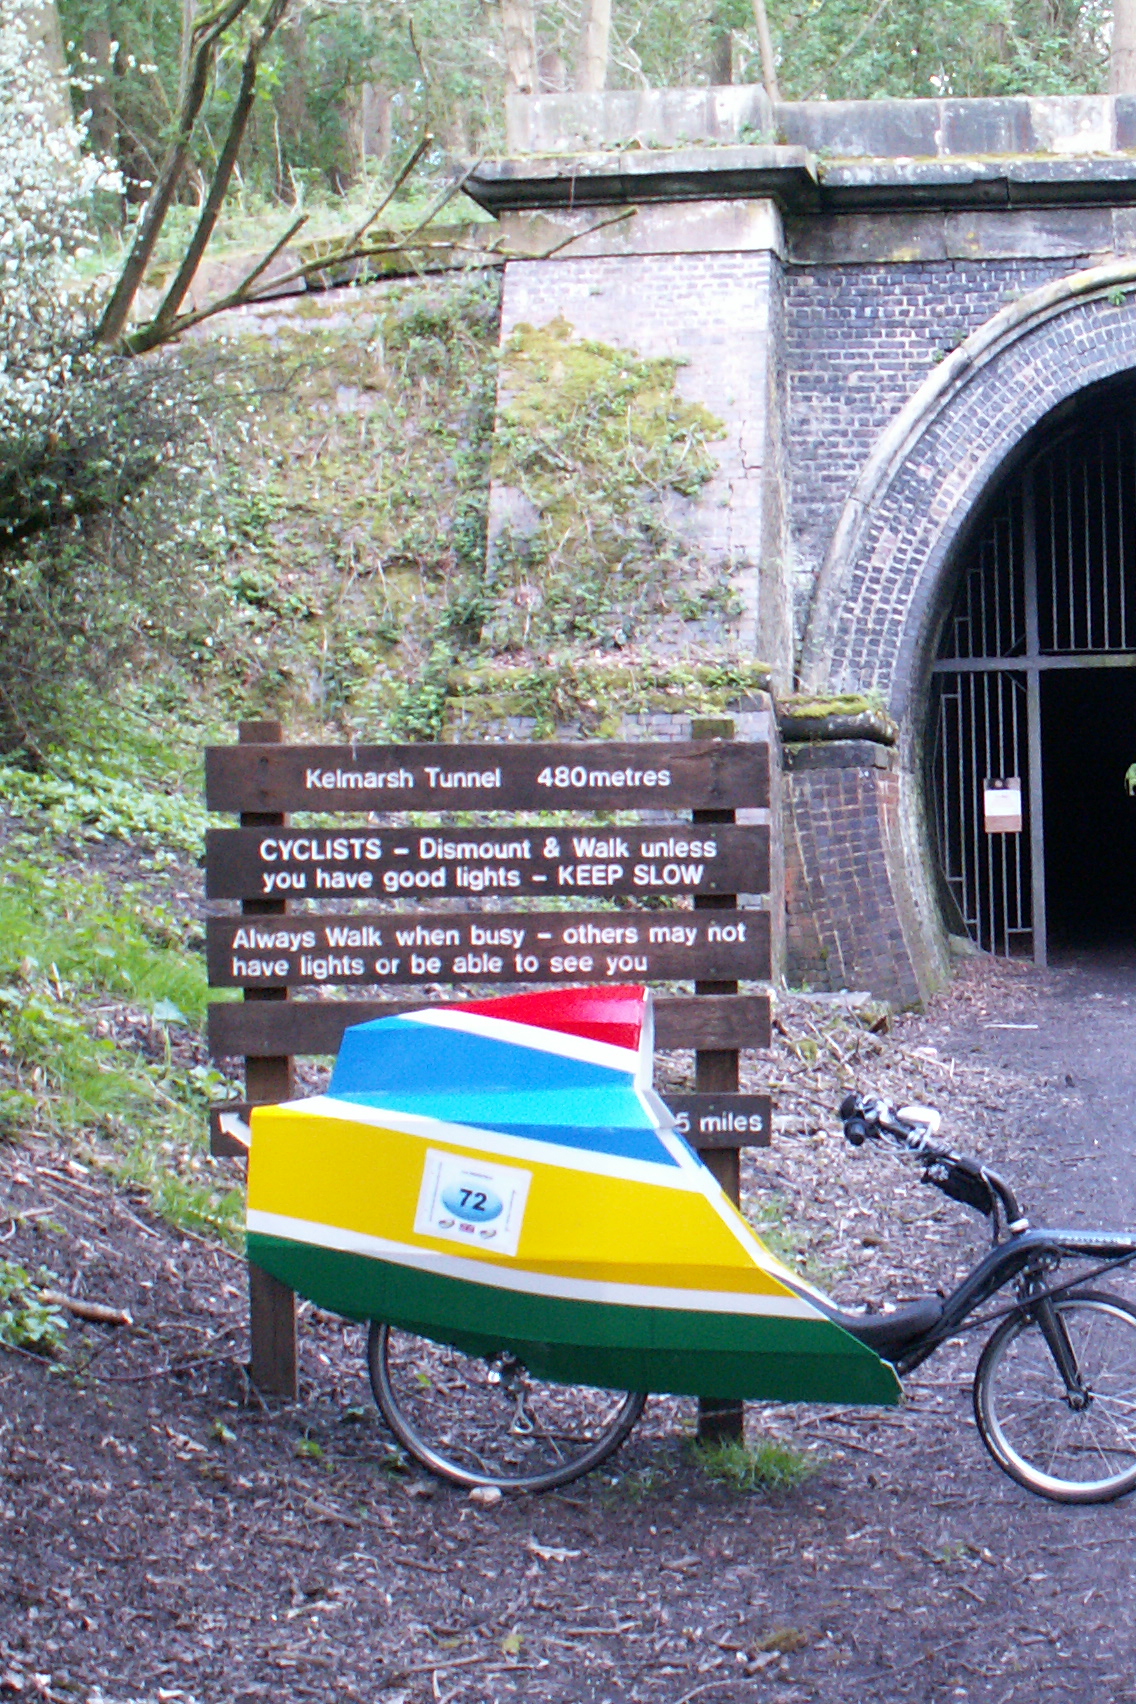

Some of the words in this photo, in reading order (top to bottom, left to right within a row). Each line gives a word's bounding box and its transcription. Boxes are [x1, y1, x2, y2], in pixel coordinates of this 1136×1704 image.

[306, 767, 413, 789] Kelmarsh
[424, 766, 501, 788] Tunnel
[259, 838, 381, 861] CYCLISTS
[419, 837, 531, 859] Dismount
[543, 837, 560, 858] &
[572, 837, 629, 858] Walk
[641, 838, 717, 858] unless
[263, 872, 305, 893] you
[317, 868, 372, 888] have
[383, 867, 445, 892] good
[456, 865, 520, 891] lights
[558, 864, 623, 886] KEEP
[633, 864, 704, 886] SLOW
[232, 928, 315, 951] Always
[325, 926, 382, 948] Walk
[396, 925, 460, 947] when
[471, 925, 525, 949] busy
[563, 923, 640, 944] others
[649, 926, 697, 948] may
[708, 921, 747, 942] not
[232, 956, 289, 977] have
[300, 954, 365, 979] lights
[375, 958, 399, 974] or
[411, 953, 441, 974] be
[453, 952, 502, 973] able
[515, 953, 539, 973] to
[550, 955, 594, 973] see
[606, 955, 648, 977] you
[700, 1110, 763, 1132] miles
[459, 1187, 488, 1212] 72
